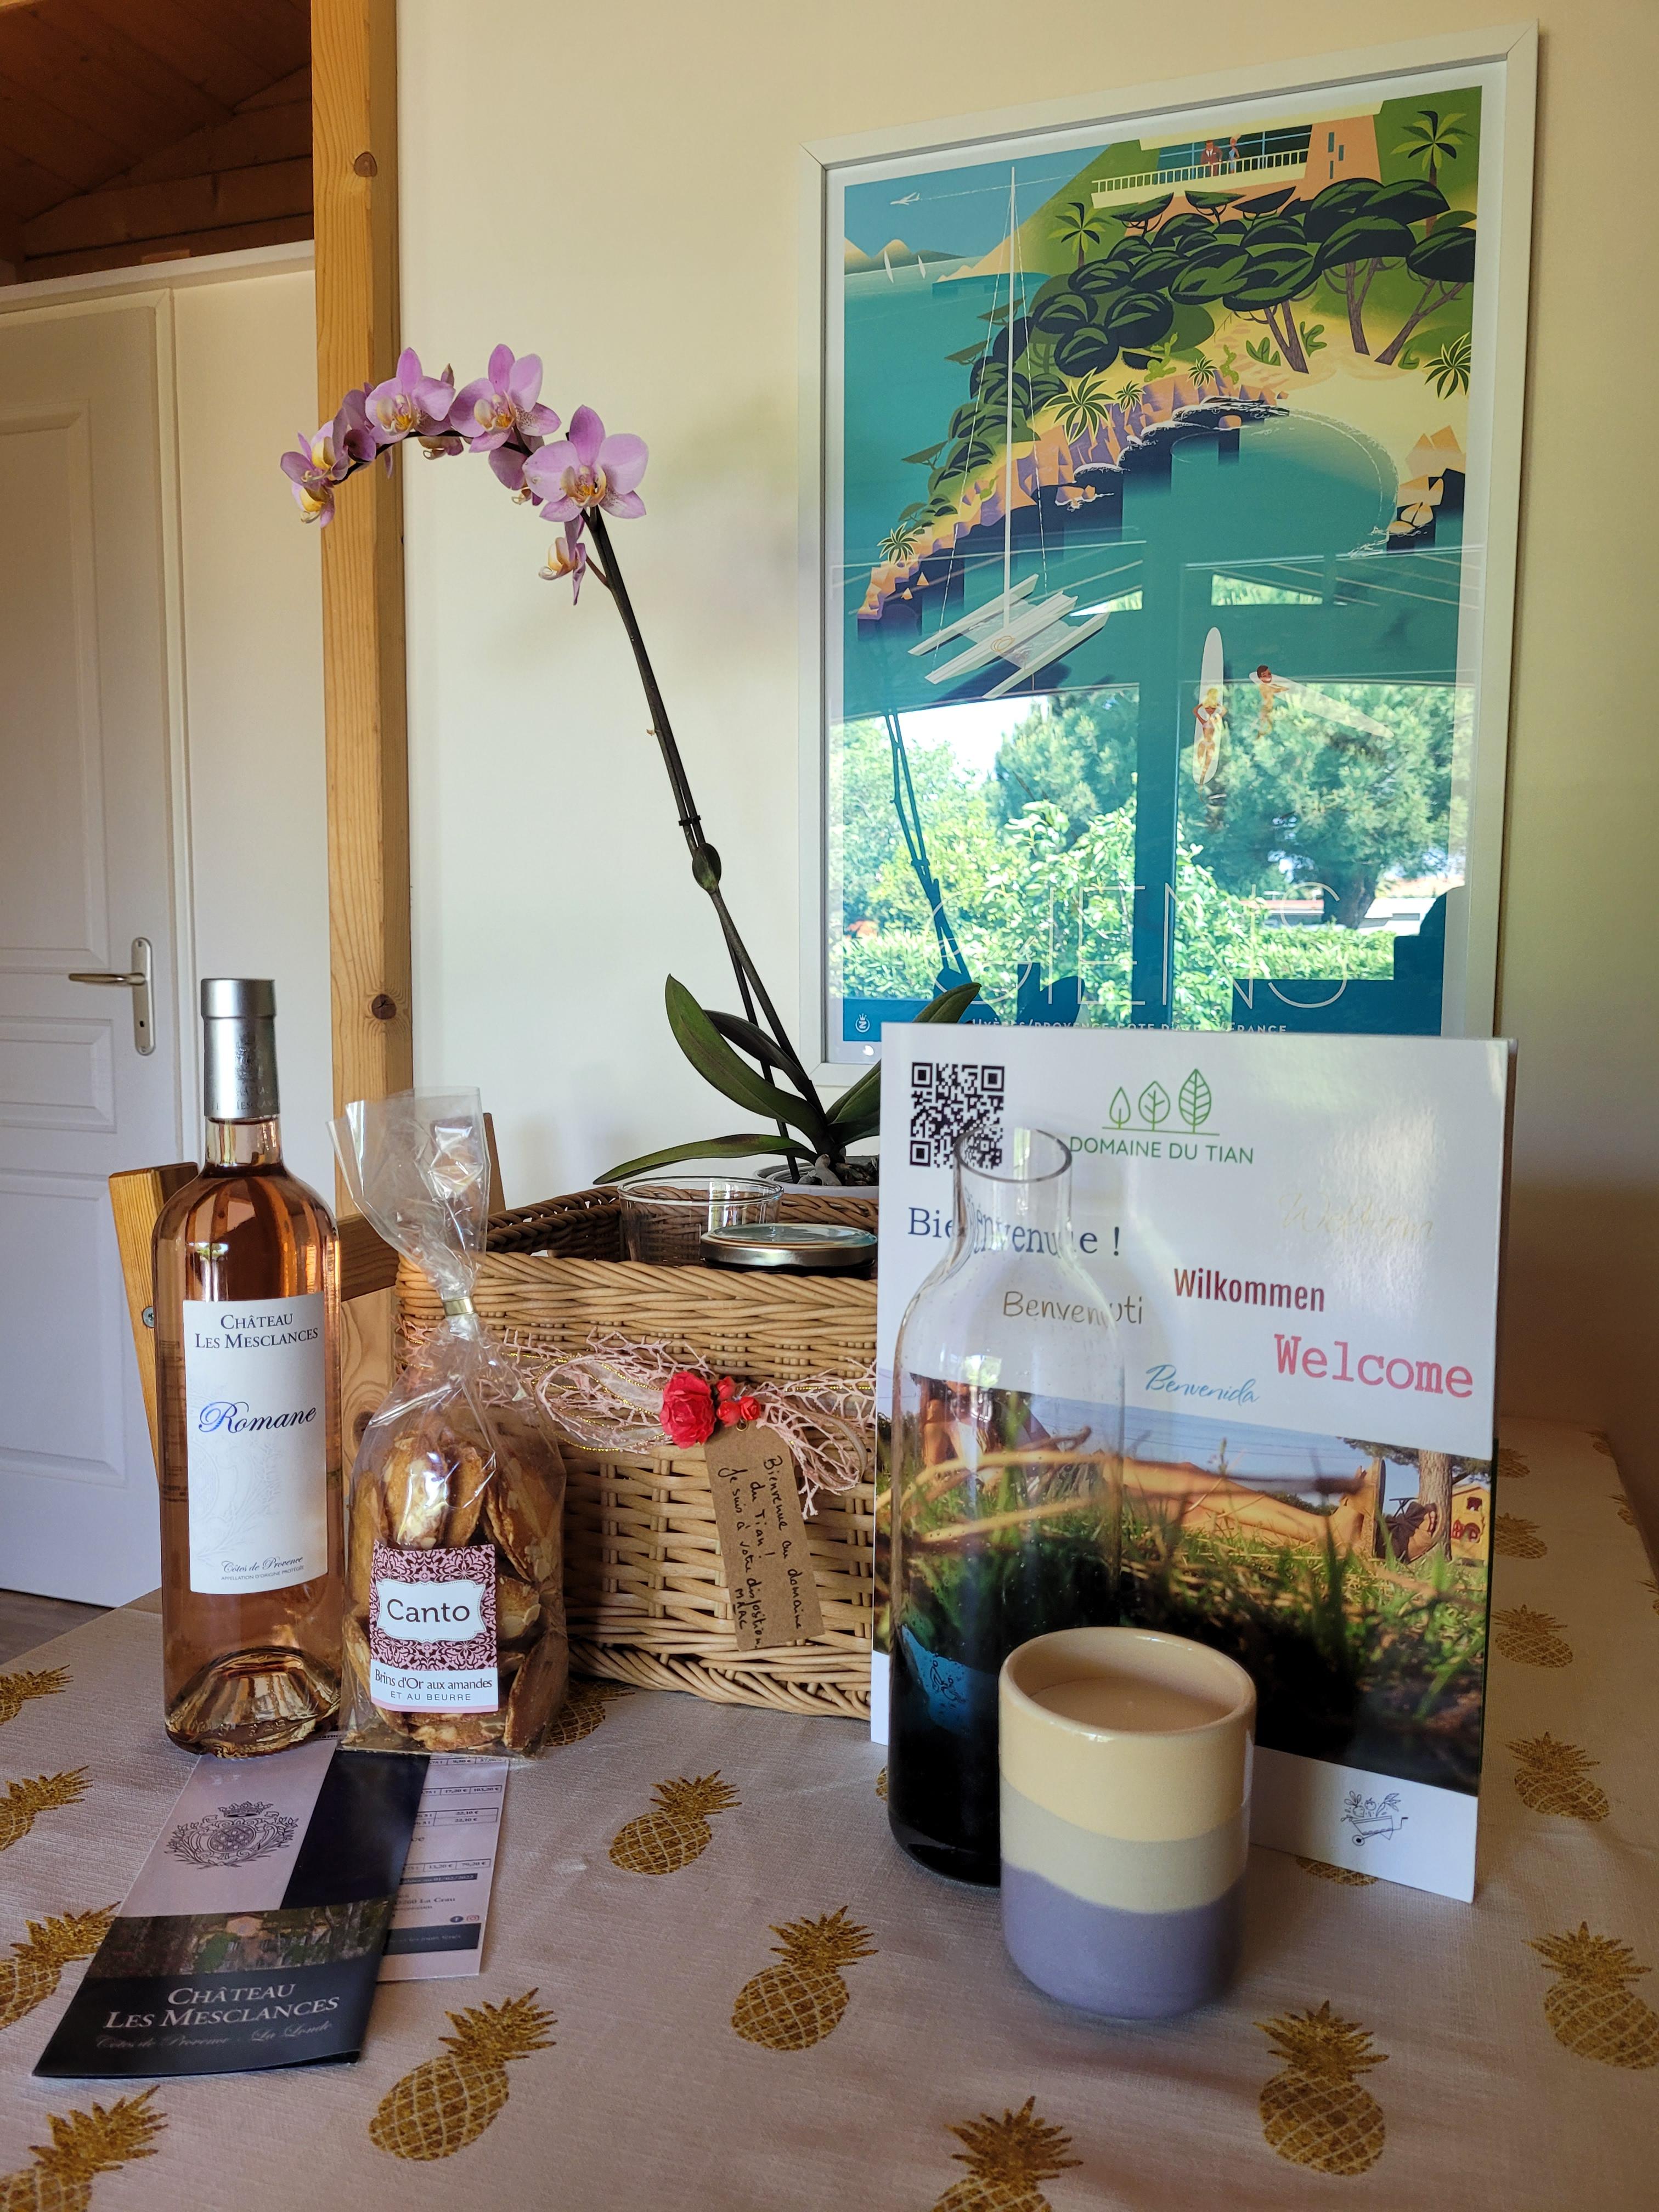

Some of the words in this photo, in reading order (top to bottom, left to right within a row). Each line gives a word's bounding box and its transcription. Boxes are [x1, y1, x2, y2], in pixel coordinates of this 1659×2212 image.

[1070, 1136, 1161, 1158] DOMAINE
[1169, 1143, 1197, 1160] DU
[1205, 1145, 1254, 1164] TIAN
[1174, 1268, 1325, 1312] Wilkommen
[221, 1313, 294, 1329] CHÂTEAU
[195, 1333, 220, 1348] LES
[225, 1328, 319, 1348] MESCLANCES
[1274, 1333, 1474, 1398] Welcome
[1146, 1364, 1260, 1406] Benvenida
[199, 1401, 317, 1434] Romane
[718, 1468, 748, 1483] Je
[732, 1488, 746, 1513] suis
[750, 1481, 765, 1502] du
[755, 1509, 767, 1547] Tian
[764, 1455, 787, 1531] Bienvenue
[782, 1541, 792, 1559] au
[787, 1569, 804, 1629] domaine
[221, 1560, 247, 1573] Côtes
[249, 1562, 259, 1571] de
[262, 1556, 303, 1570] Provence
[740, 1541, 754, 1573] votre
[387, 1599, 470, 1623] Canto
[375, 1668, 396, 1686] Brins
[398, 1677, 424, 1689] d'Or
[427, 1681, 445, 1689] aux
[448, 1678, 492, 1690] amandes
[167, 1984, 296, 2005] CHÂTEAU
[103, 2012, 155, 2028] LES
[160, 1996, 340, 2027] MESCLANCES
